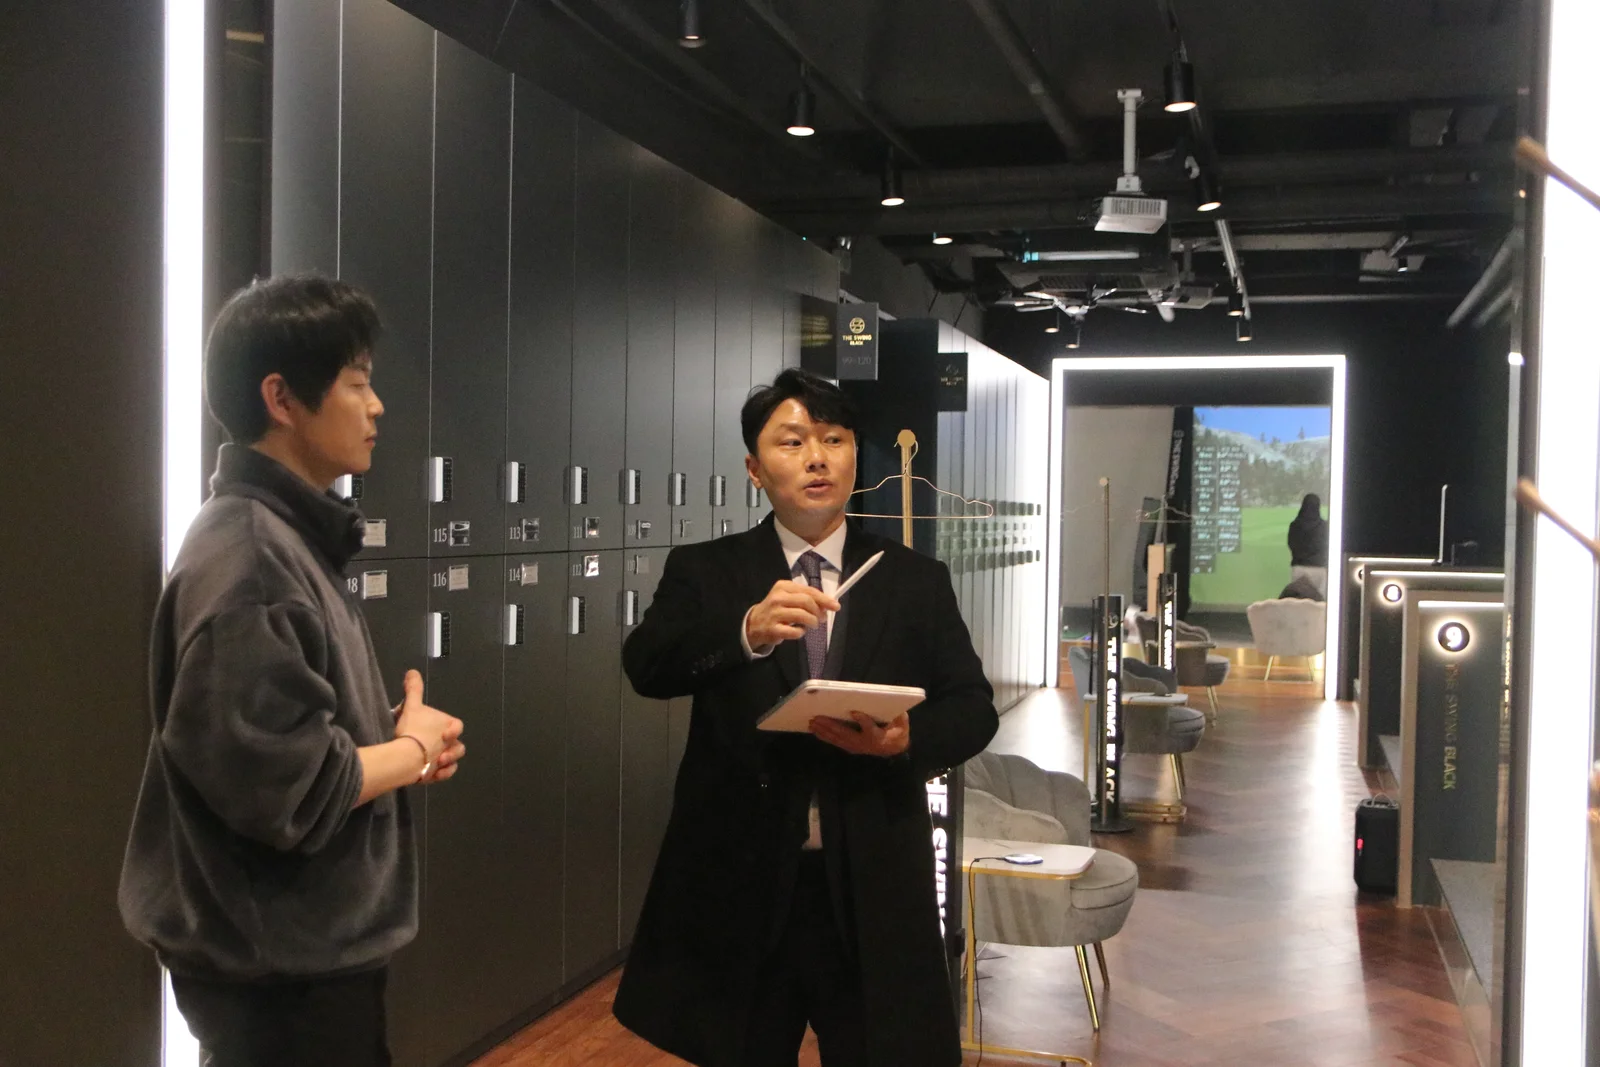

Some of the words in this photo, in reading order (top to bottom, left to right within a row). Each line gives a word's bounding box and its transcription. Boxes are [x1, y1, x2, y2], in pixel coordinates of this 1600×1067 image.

[433, 528, 448, 543] 115
[509, 526, 521, 540] 113
[573, 526, 583, 539] 111
[509, 568, 521, 582] 114
[572, 563, 582, 576] 112
[346, 577, 358, 593] 18
[433, 571, 447, 587] 116
[1445, 626, 1463, 648] 9
[1442, 745, 1457, 790] BLACK
[926, 774, 948, 816] HE
